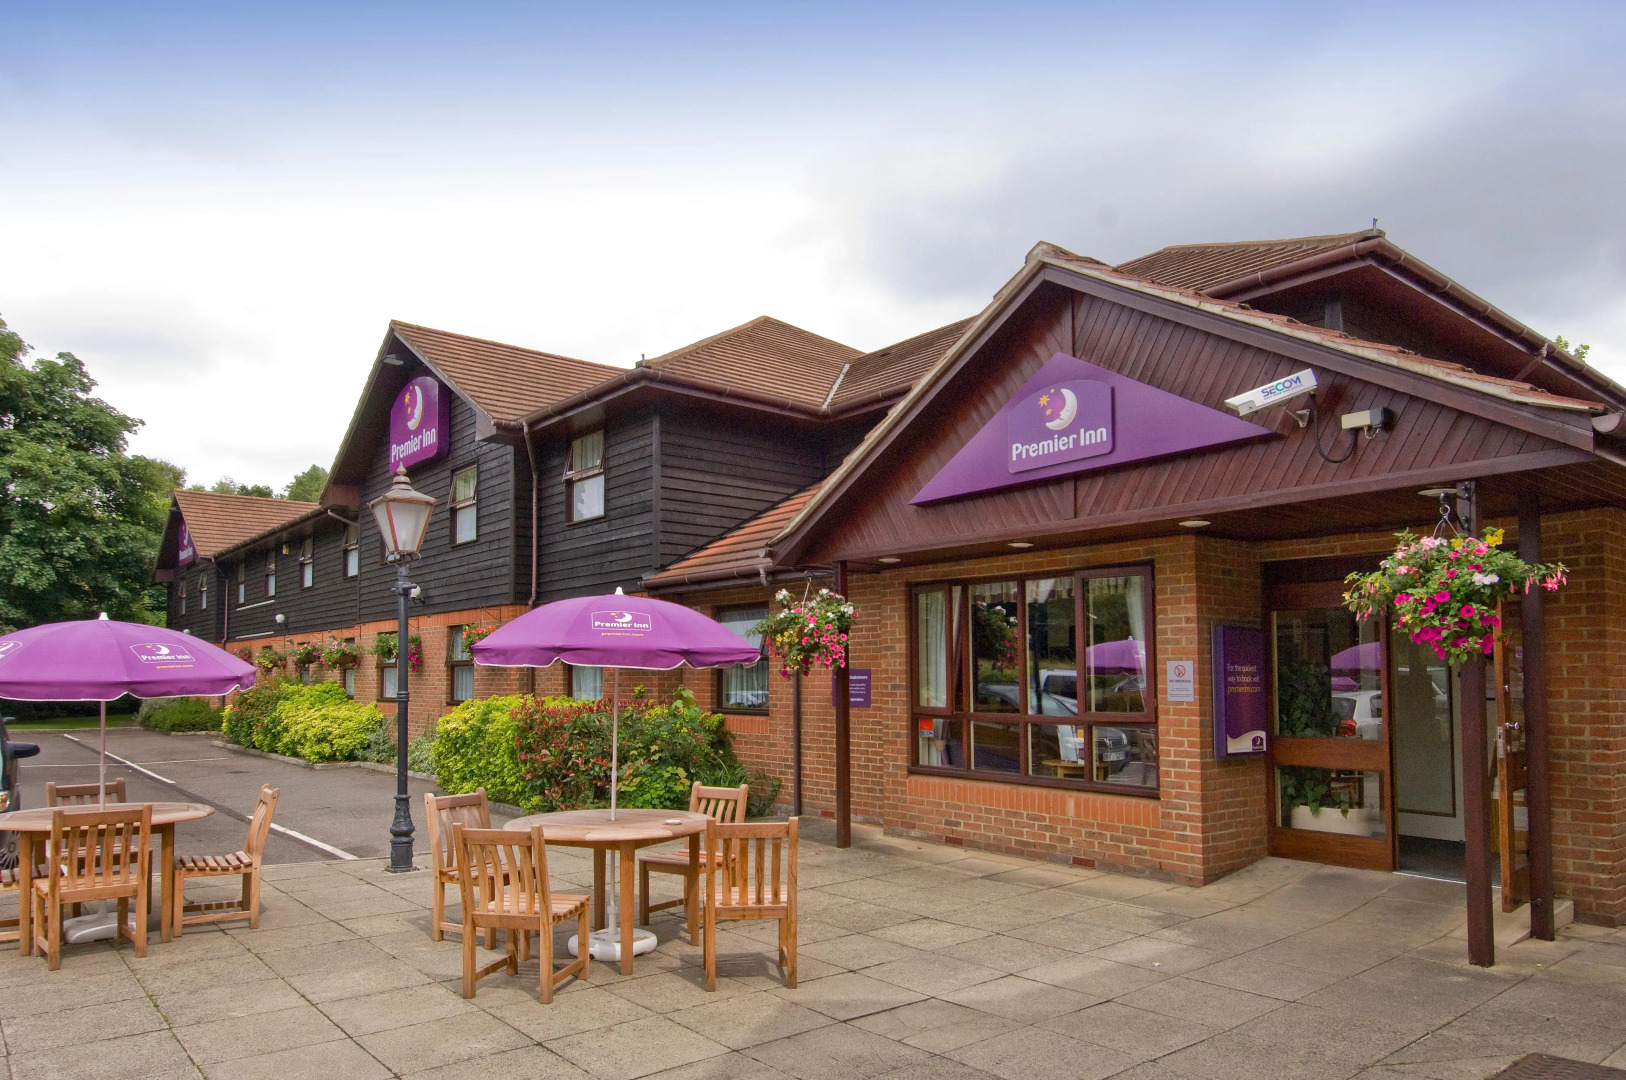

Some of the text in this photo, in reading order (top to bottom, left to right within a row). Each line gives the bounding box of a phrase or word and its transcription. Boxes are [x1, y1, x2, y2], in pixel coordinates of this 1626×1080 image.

[1261, 376, 1302, 398] SECOM
[391, 427, 436, 463] Premier Inn
[1012, 427, 1107, 461] Premier Inn
